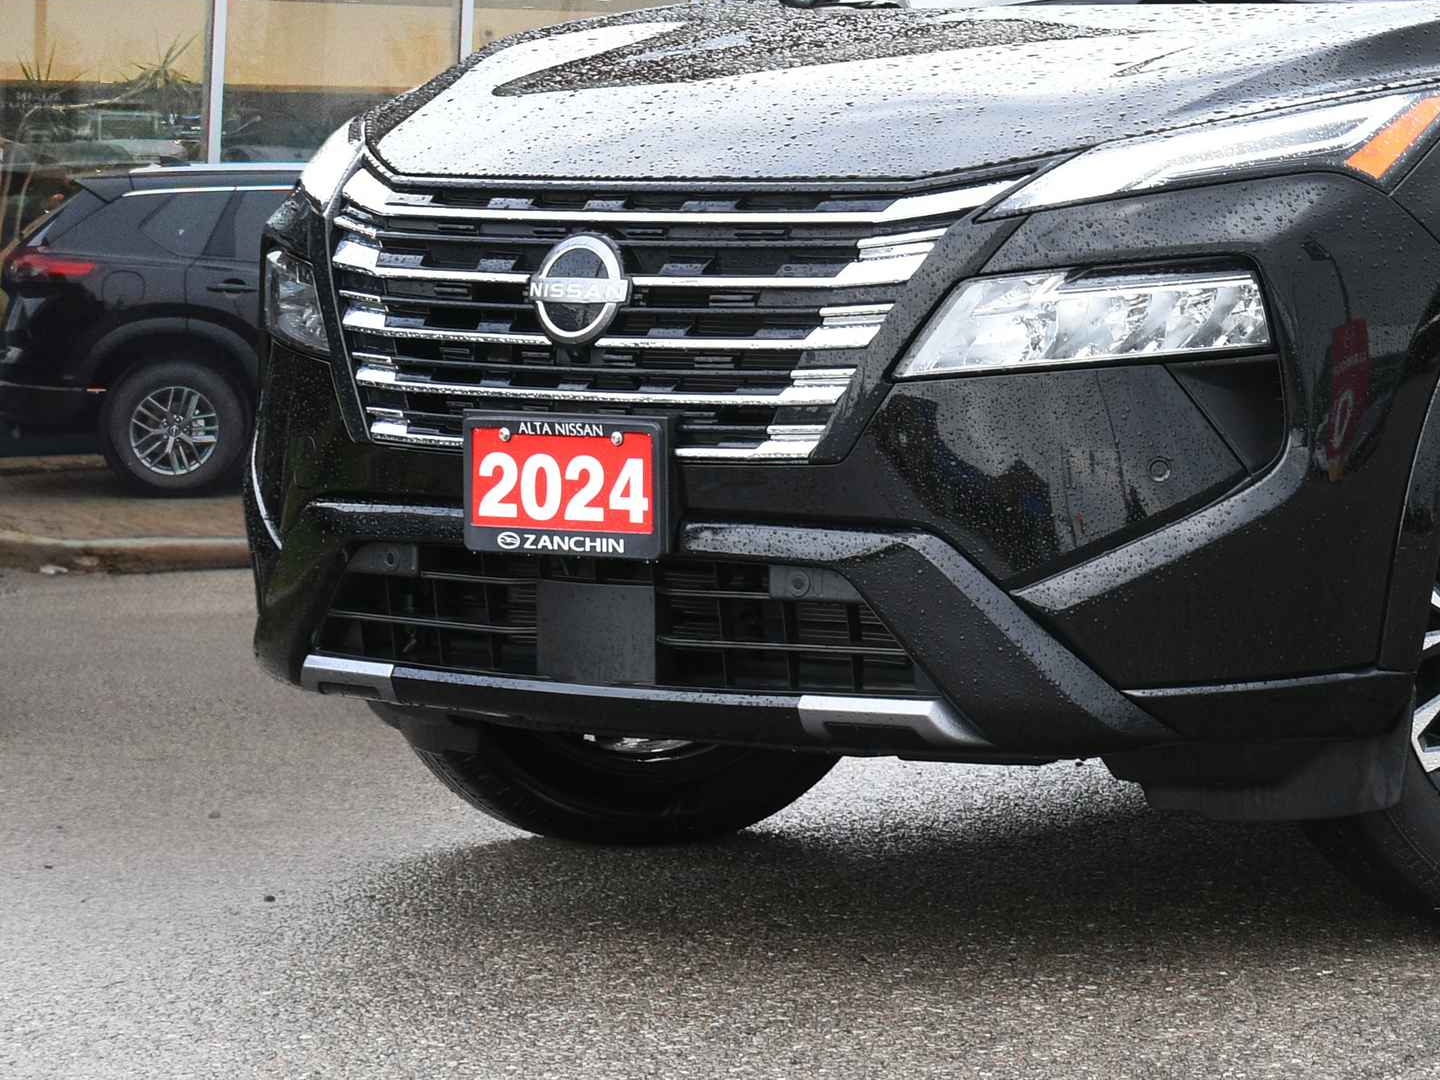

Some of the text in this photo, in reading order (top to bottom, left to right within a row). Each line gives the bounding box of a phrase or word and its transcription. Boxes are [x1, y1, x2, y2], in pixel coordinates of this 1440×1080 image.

[529, 281, 626, 300] NISSAN
[518, 421, 604, 437] ALTA NISSAN
[478, 451, 649, 524] 2024
[523, 534, 625, 554] ZANCHIN
